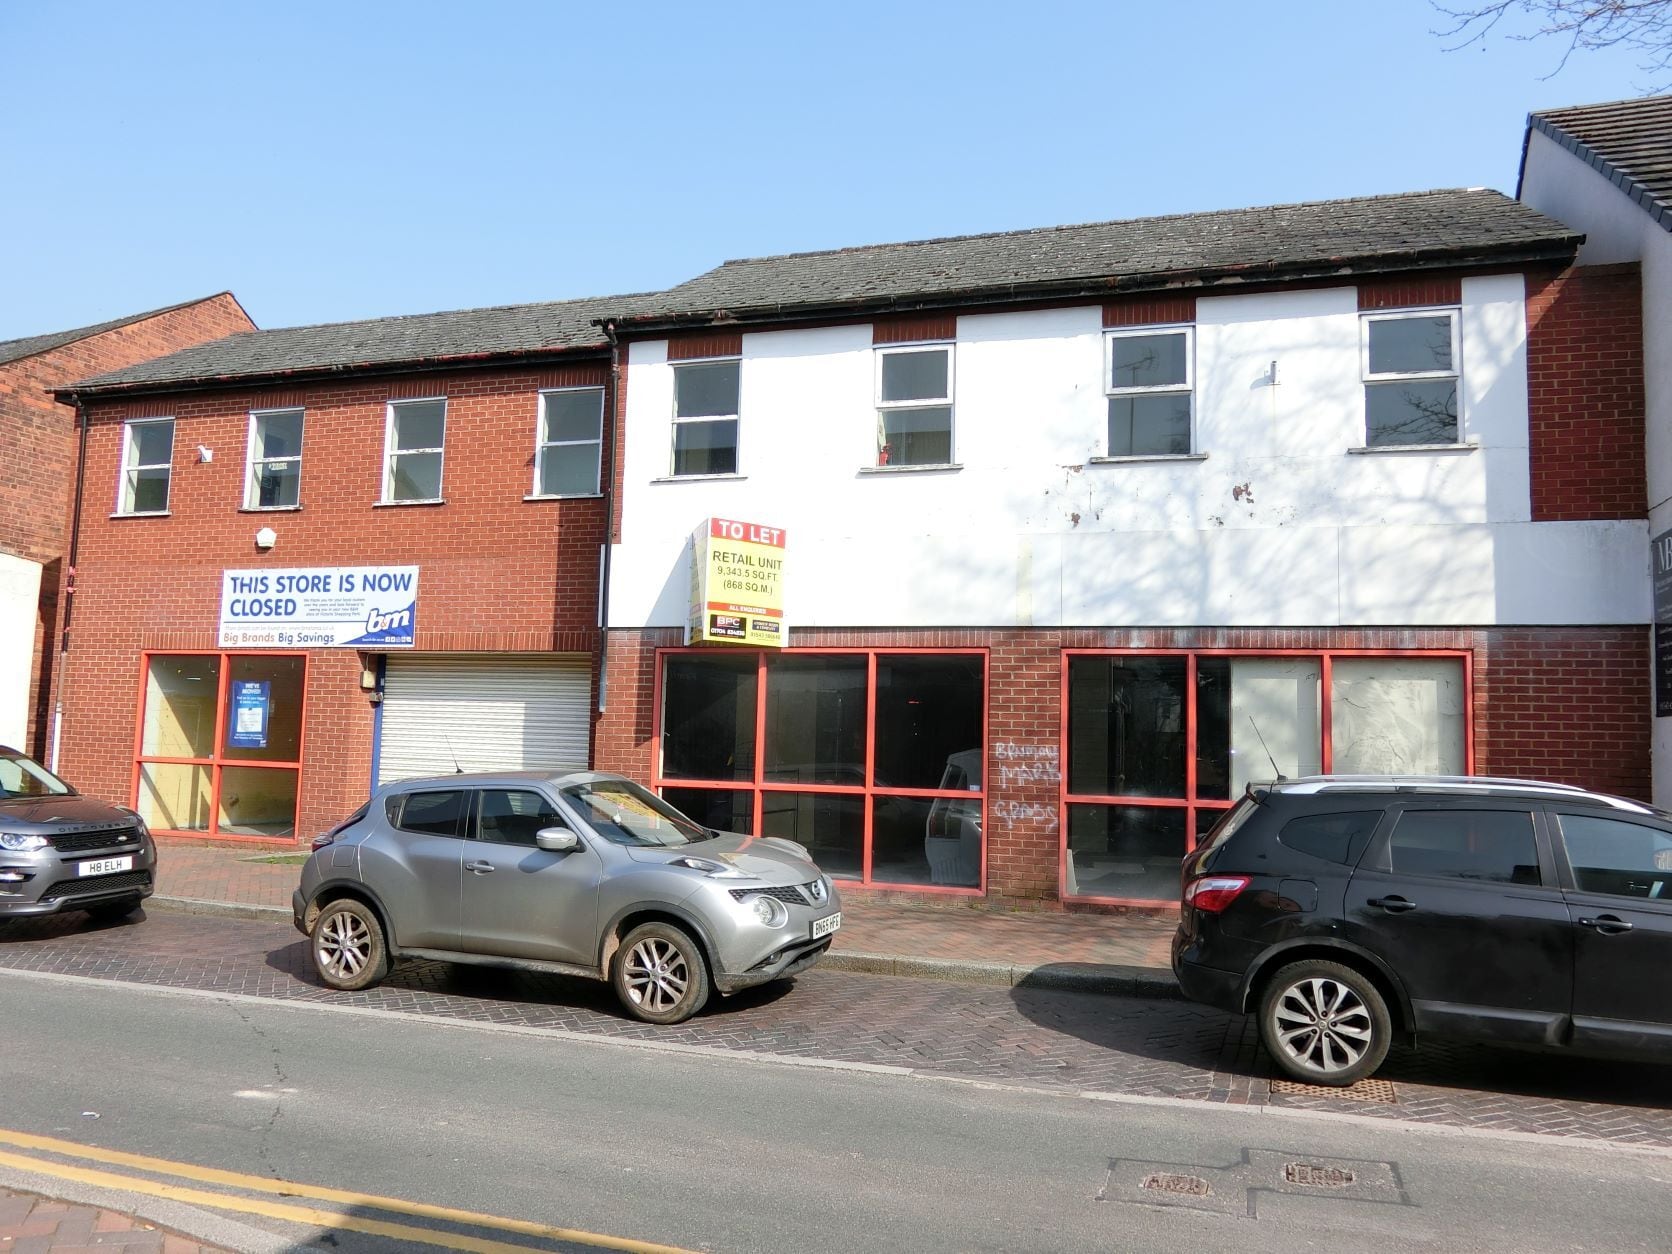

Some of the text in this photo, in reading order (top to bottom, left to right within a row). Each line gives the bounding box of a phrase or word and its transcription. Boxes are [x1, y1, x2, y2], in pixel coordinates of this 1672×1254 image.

[719, 521, 780, 545] TO LET
[713, 550, 783, 570] RETAIL UNIT
[717, 565, 750, 578] 9,343.5
[230, 573, 412, 594] THIS STORE IS NOW
[723, 579, 773, 595] (868 SQ.M.)
[230, 598, 297, 617] CLOSED
[717, 616, 740, 626] BPC
[224, 632, 335, 645] Big Brands Big Savings
[58, 822, 127, 833] DISCOVERY
[89, 861, 122, 873] H8 ELH
